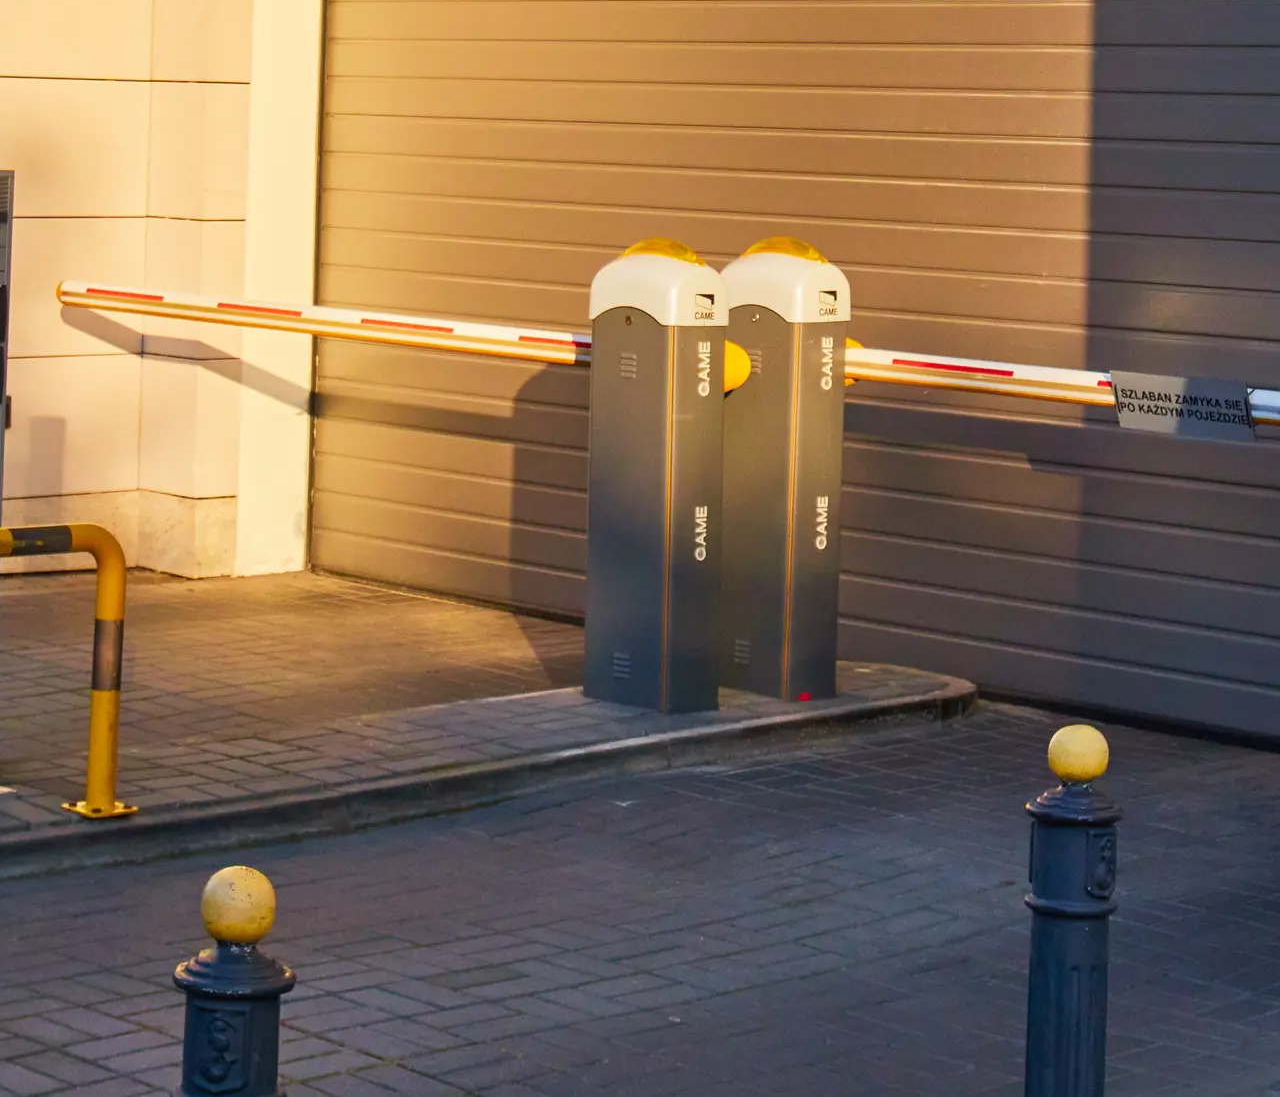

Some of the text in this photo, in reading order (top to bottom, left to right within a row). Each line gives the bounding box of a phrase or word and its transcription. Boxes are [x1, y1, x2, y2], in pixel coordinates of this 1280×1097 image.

[694, 312, 715, 320] CAME
[819, 308, 838, 316] CAME
[697, 341, 711, 397] CAME
[820, 336, 833, 390] CAME
[1120, 388, 1172, 404] SZLABAN
[1175, 394, 1223, 409] ZAMYKA
[1120, 402, 1136, 413] PO
[1138, 403, 1185, 419] KAŻDYM
[694, 505, 708, 562] CAME
[815, 495, 829, 550] CAME
